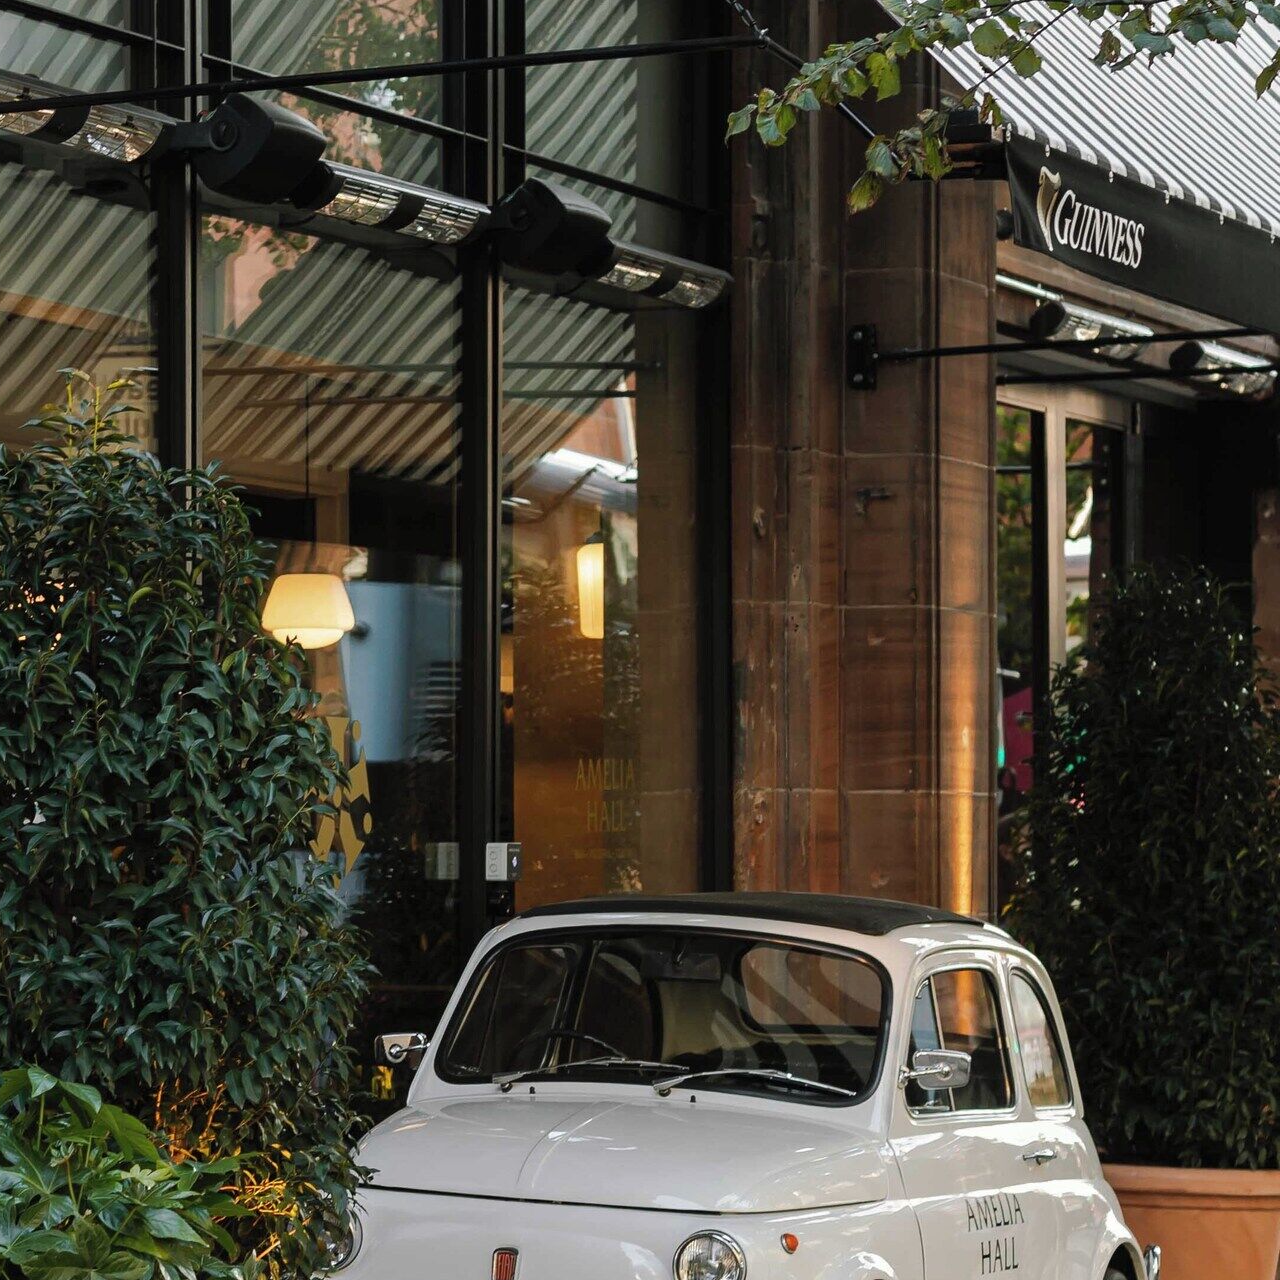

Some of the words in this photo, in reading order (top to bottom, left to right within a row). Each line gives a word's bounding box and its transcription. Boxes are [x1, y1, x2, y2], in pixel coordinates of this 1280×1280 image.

[1054, 189, 1145, 269] GUINNESS
[575, 758, 636, 791] AMELIA
[587, 800, 627, 832] HALL
[965, 1193, 1025, 1232] AMELIA
[981, 1237, 1019, 1275] HALL
